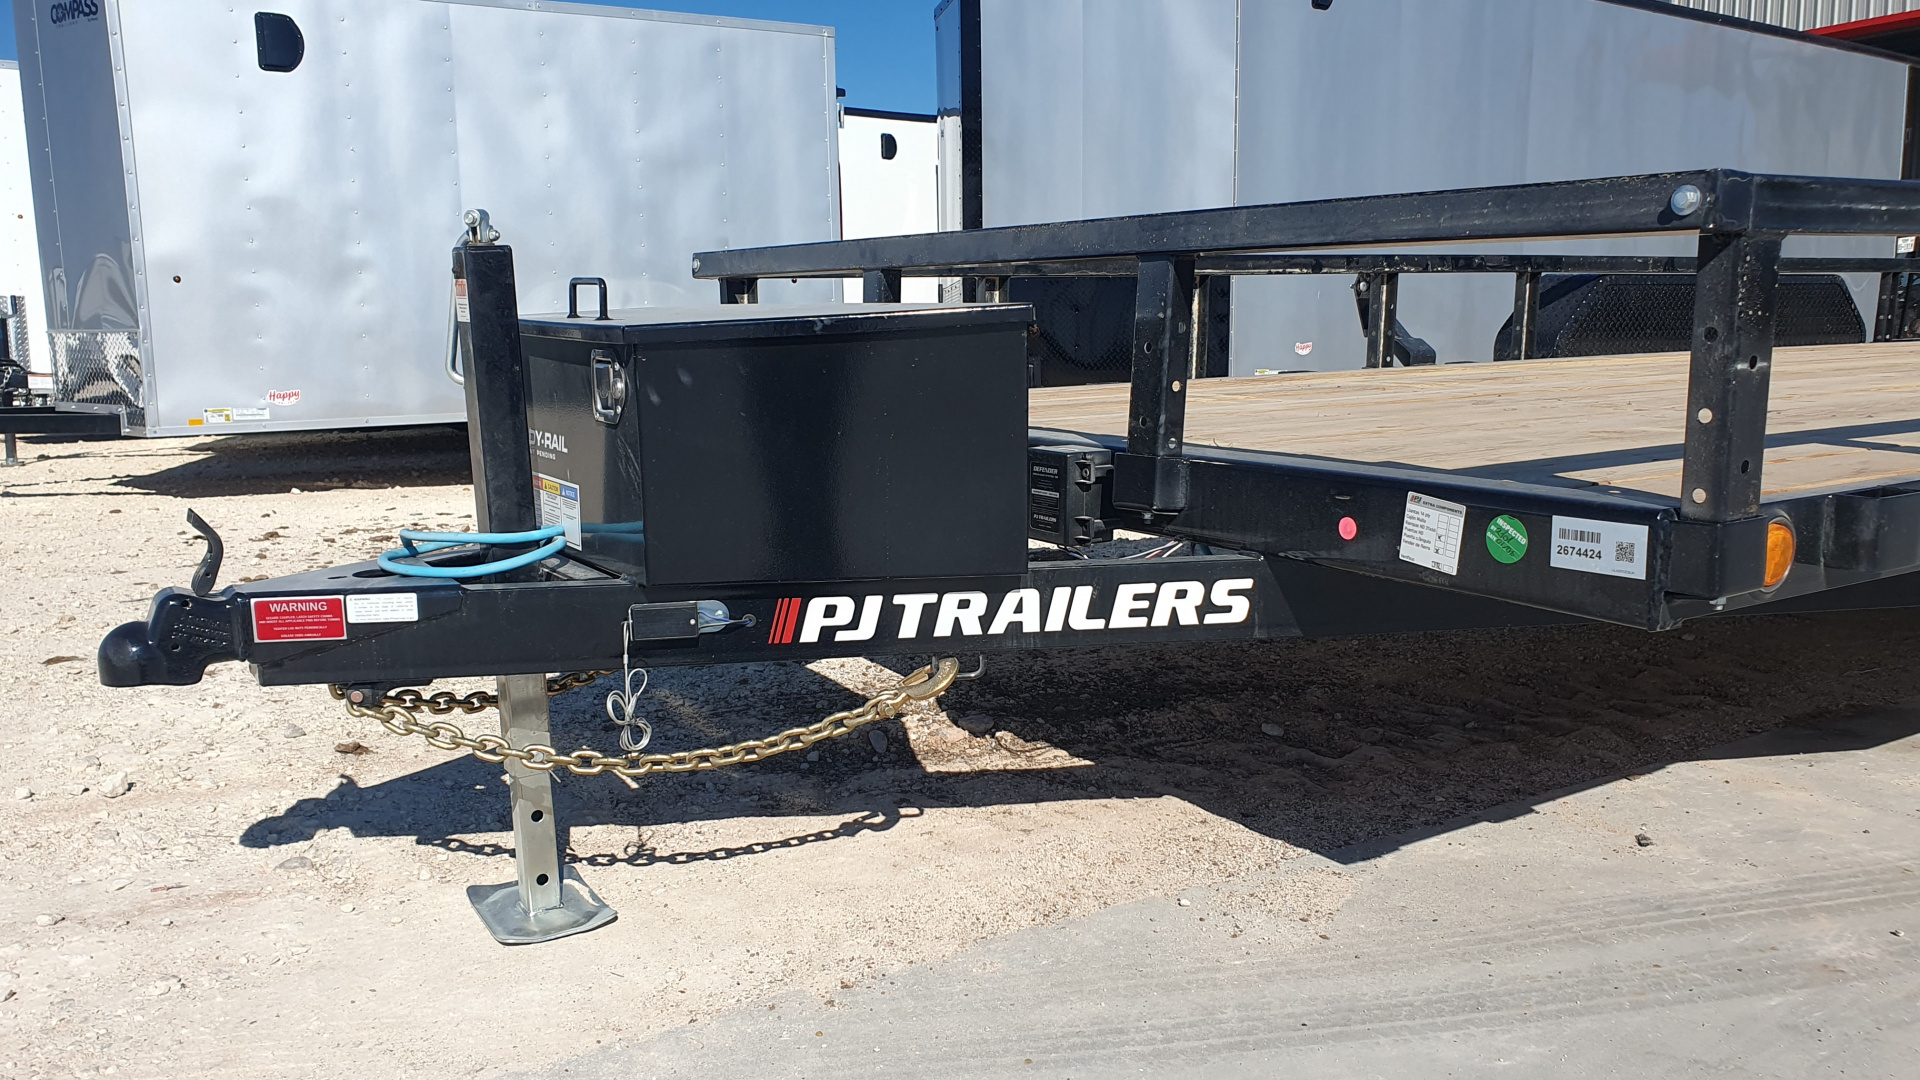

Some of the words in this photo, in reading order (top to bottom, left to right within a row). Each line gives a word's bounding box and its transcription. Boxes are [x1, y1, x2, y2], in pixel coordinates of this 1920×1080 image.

[51, 0, 98, 24] COMPASS
[269, 390, 300, 402] Happy
[1436, 504, 1462, 515] COMPONENTS
[1496, 517, 1527, 545] INSPECTED
[1556, 544, 1602, 560] 2674424
[269, 601, 328, 613] WARNING
[799, 595, 883, 643] PJ
[892, 578, 1255, 640] TRAILERS
